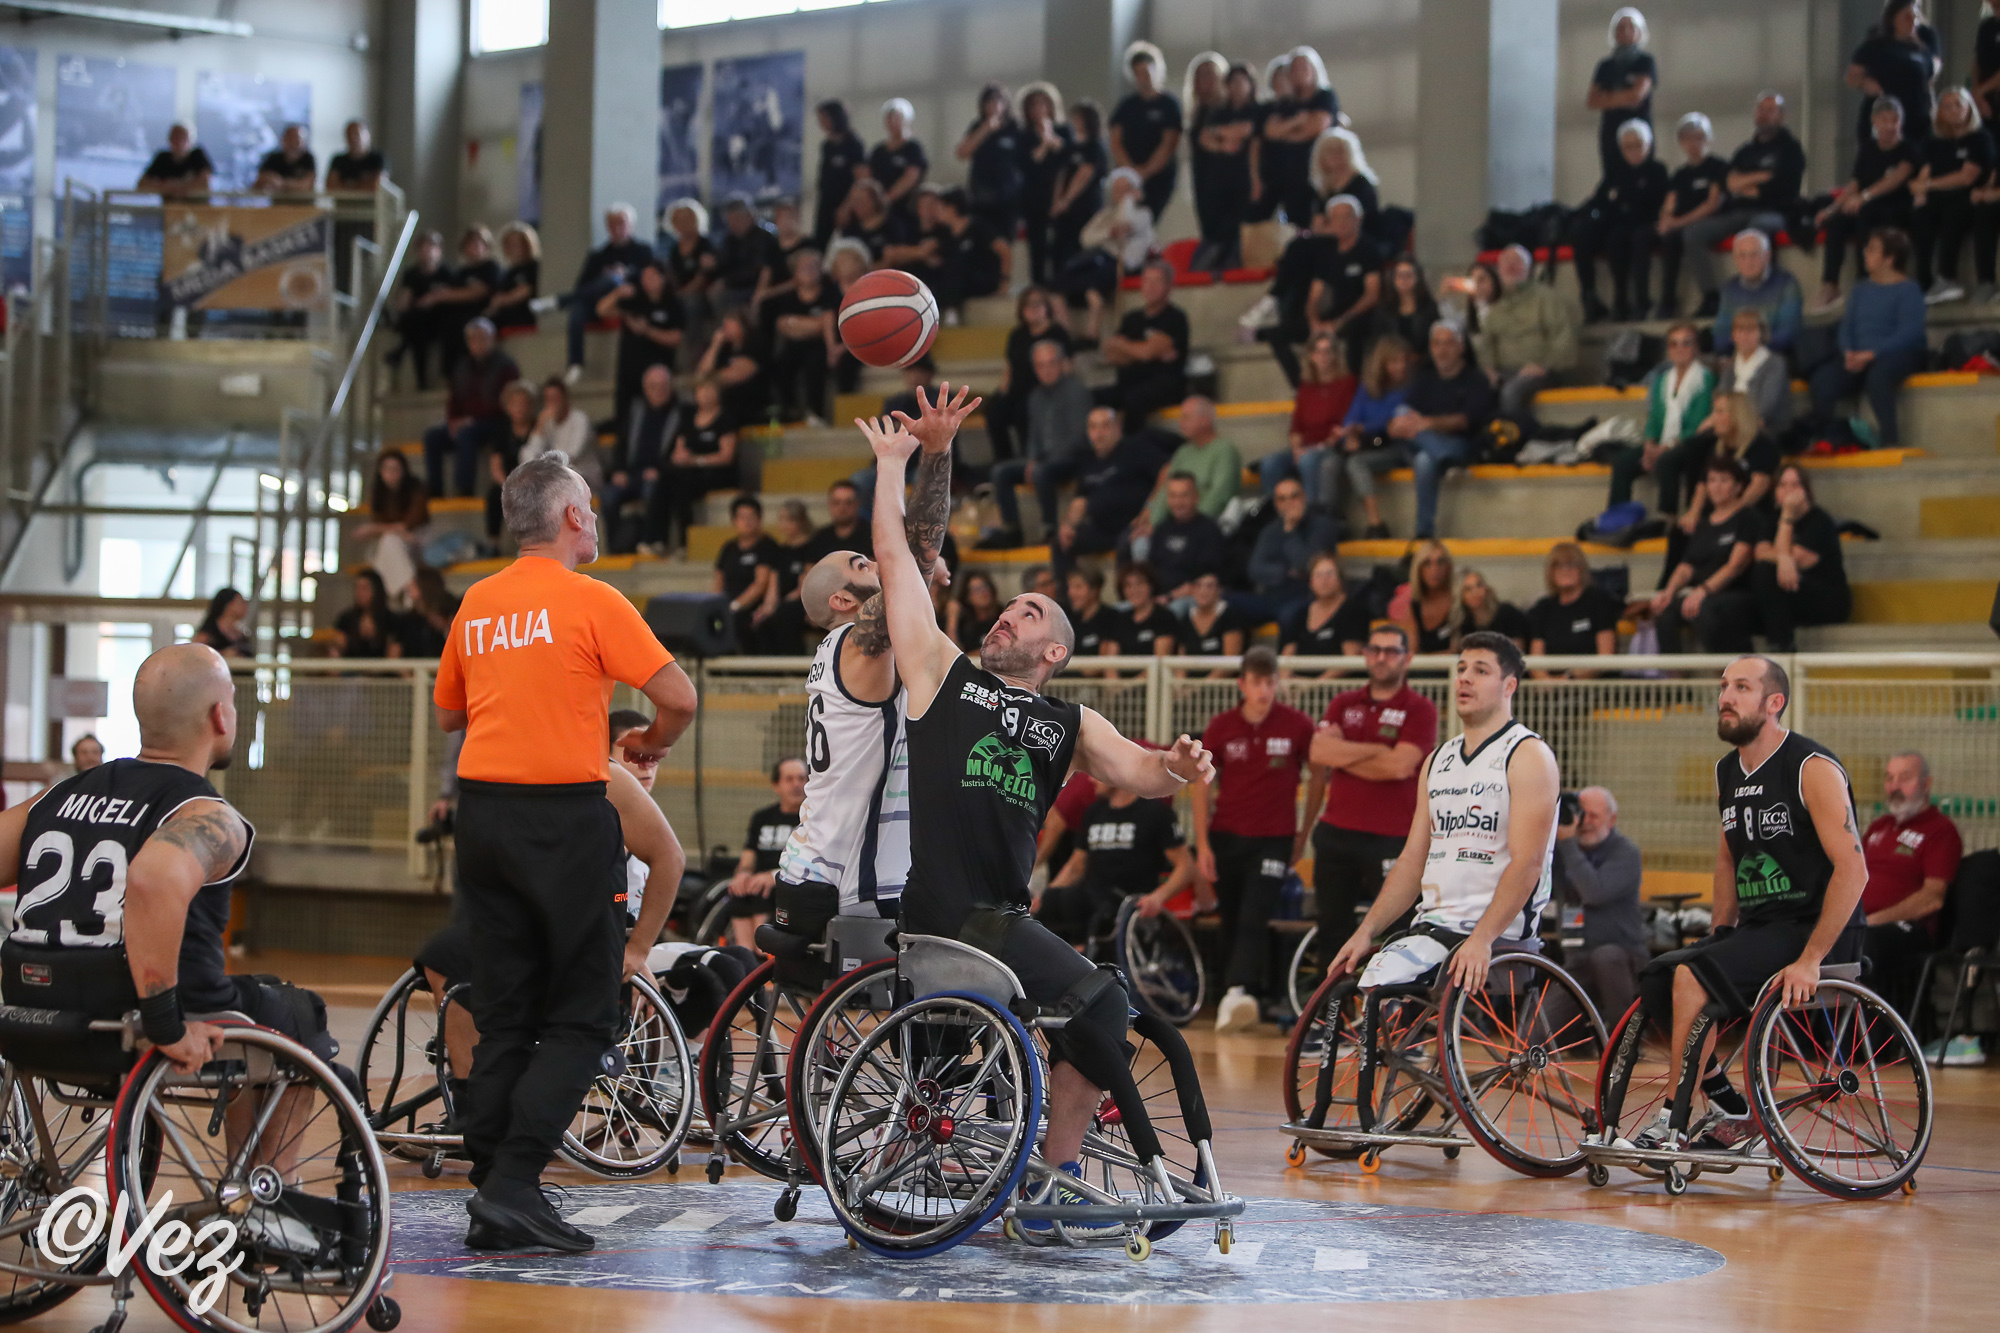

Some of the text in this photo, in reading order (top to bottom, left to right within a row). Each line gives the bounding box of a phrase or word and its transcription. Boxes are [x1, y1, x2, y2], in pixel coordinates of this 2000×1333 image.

[465, 608, 554, 657] ITALIA
[960, 693, 999, 712] BASKET
[963, 681, 999, 704] SBS
[1028, 720, 1060, 745] KCS
[56, 793, 150, 828] MICELI
[1761, 811, 1788, 825] KCS
[10, 830, 128, 948] 23
[447, 1262, 850, 1295] MEDA
